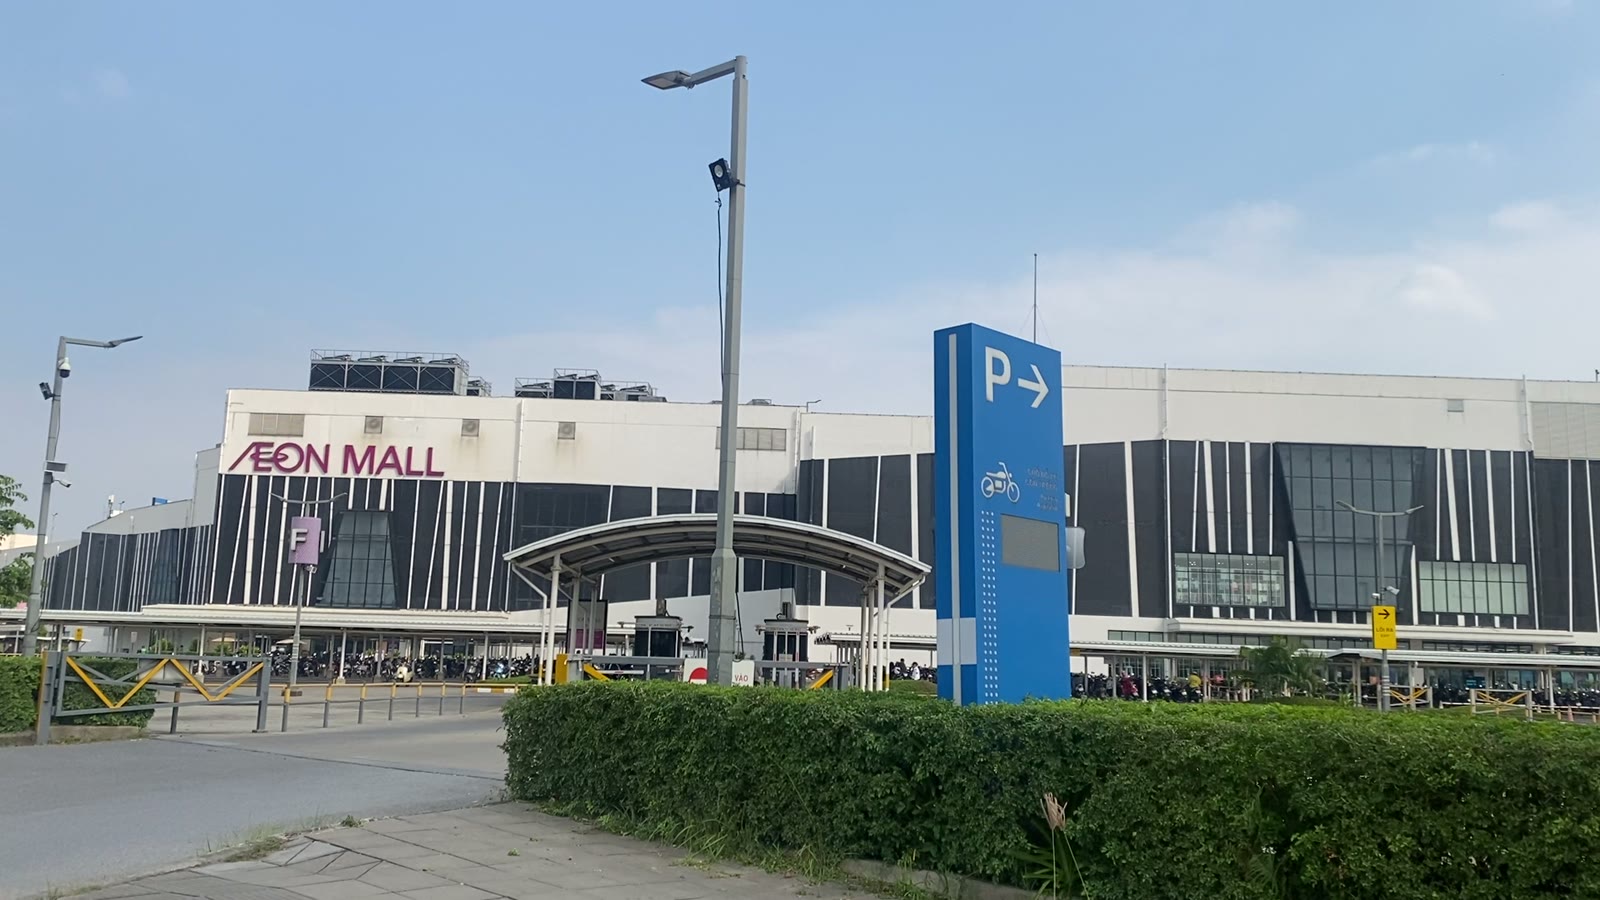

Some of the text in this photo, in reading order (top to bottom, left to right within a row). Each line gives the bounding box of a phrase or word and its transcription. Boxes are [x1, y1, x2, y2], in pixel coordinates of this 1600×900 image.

[985, 346, 1011, 403] P
[342, 444, 445, 477] MALL
[290, 528, 308, 551] F
